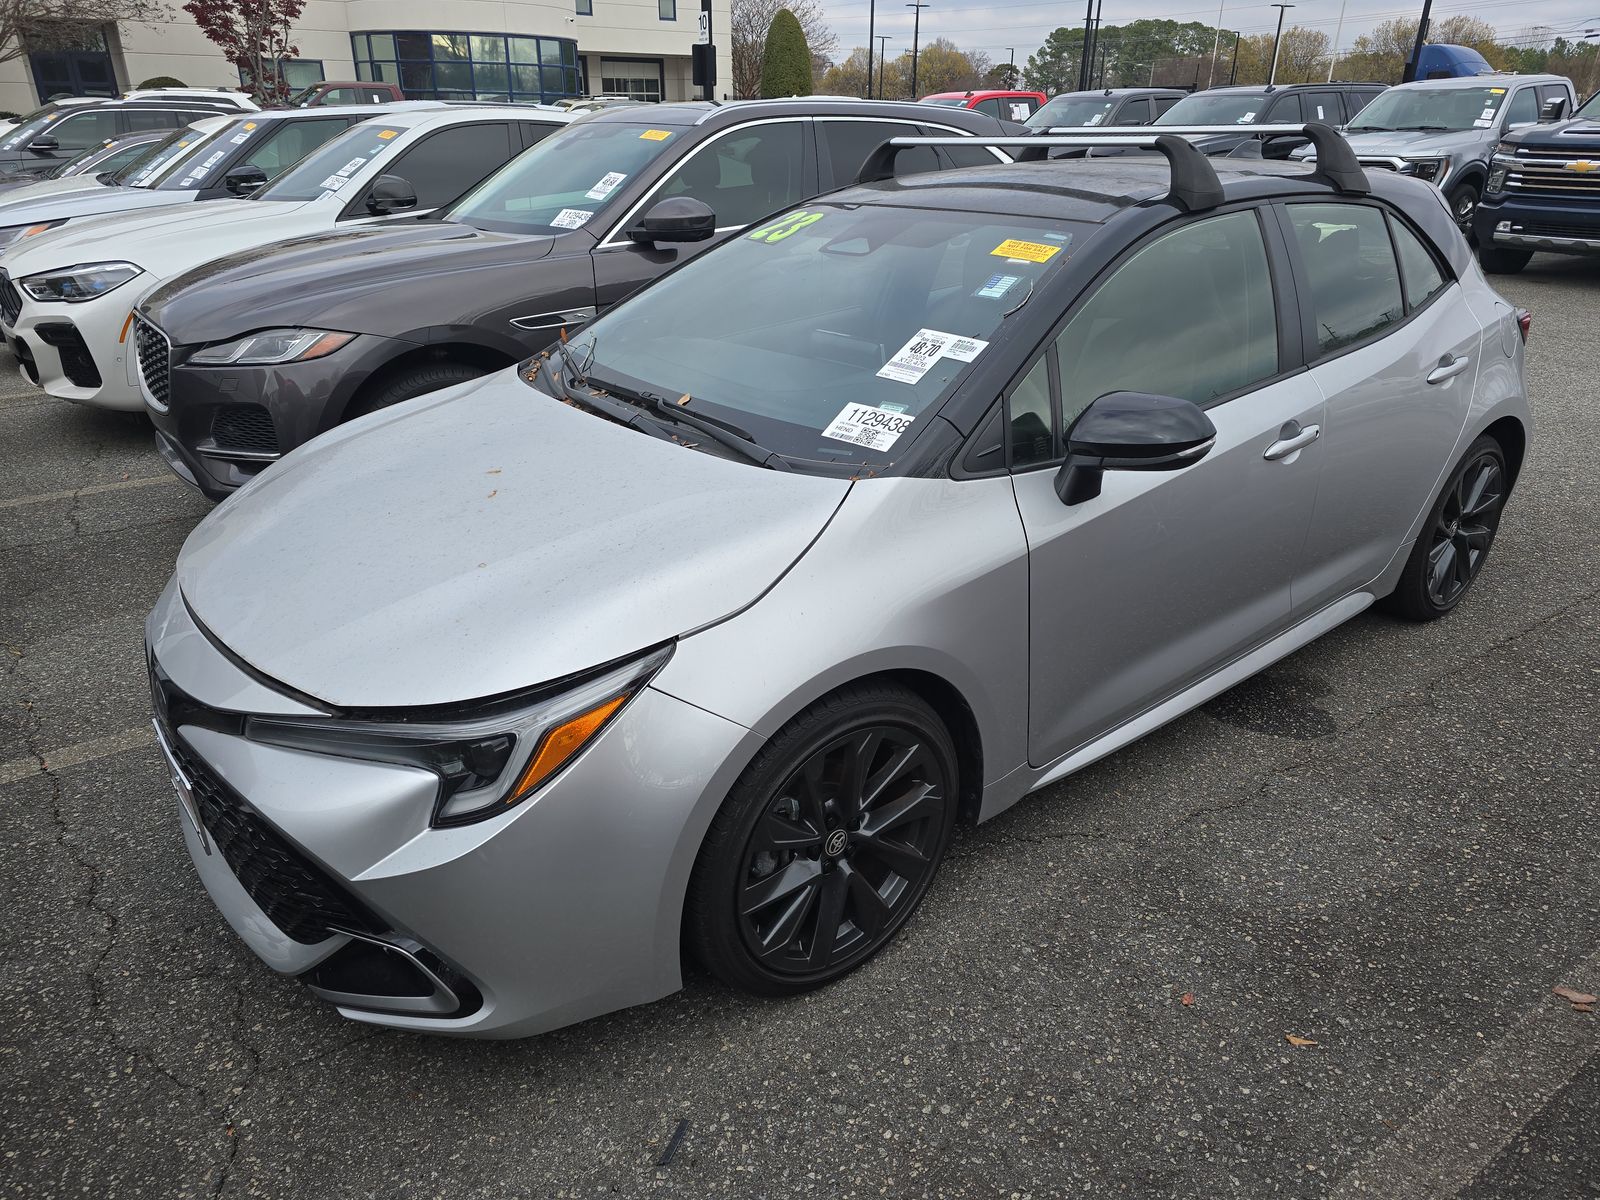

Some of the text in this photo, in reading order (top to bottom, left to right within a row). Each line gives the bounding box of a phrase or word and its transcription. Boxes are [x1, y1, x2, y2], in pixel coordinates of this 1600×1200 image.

[698, 14, 707, 30] 10
[748, 211, 824, 243] 23
[909, 341, 942, 357] 48:70
[907, 354, 927, 362] 2023
[848, 407, 912, 434] 1129438
